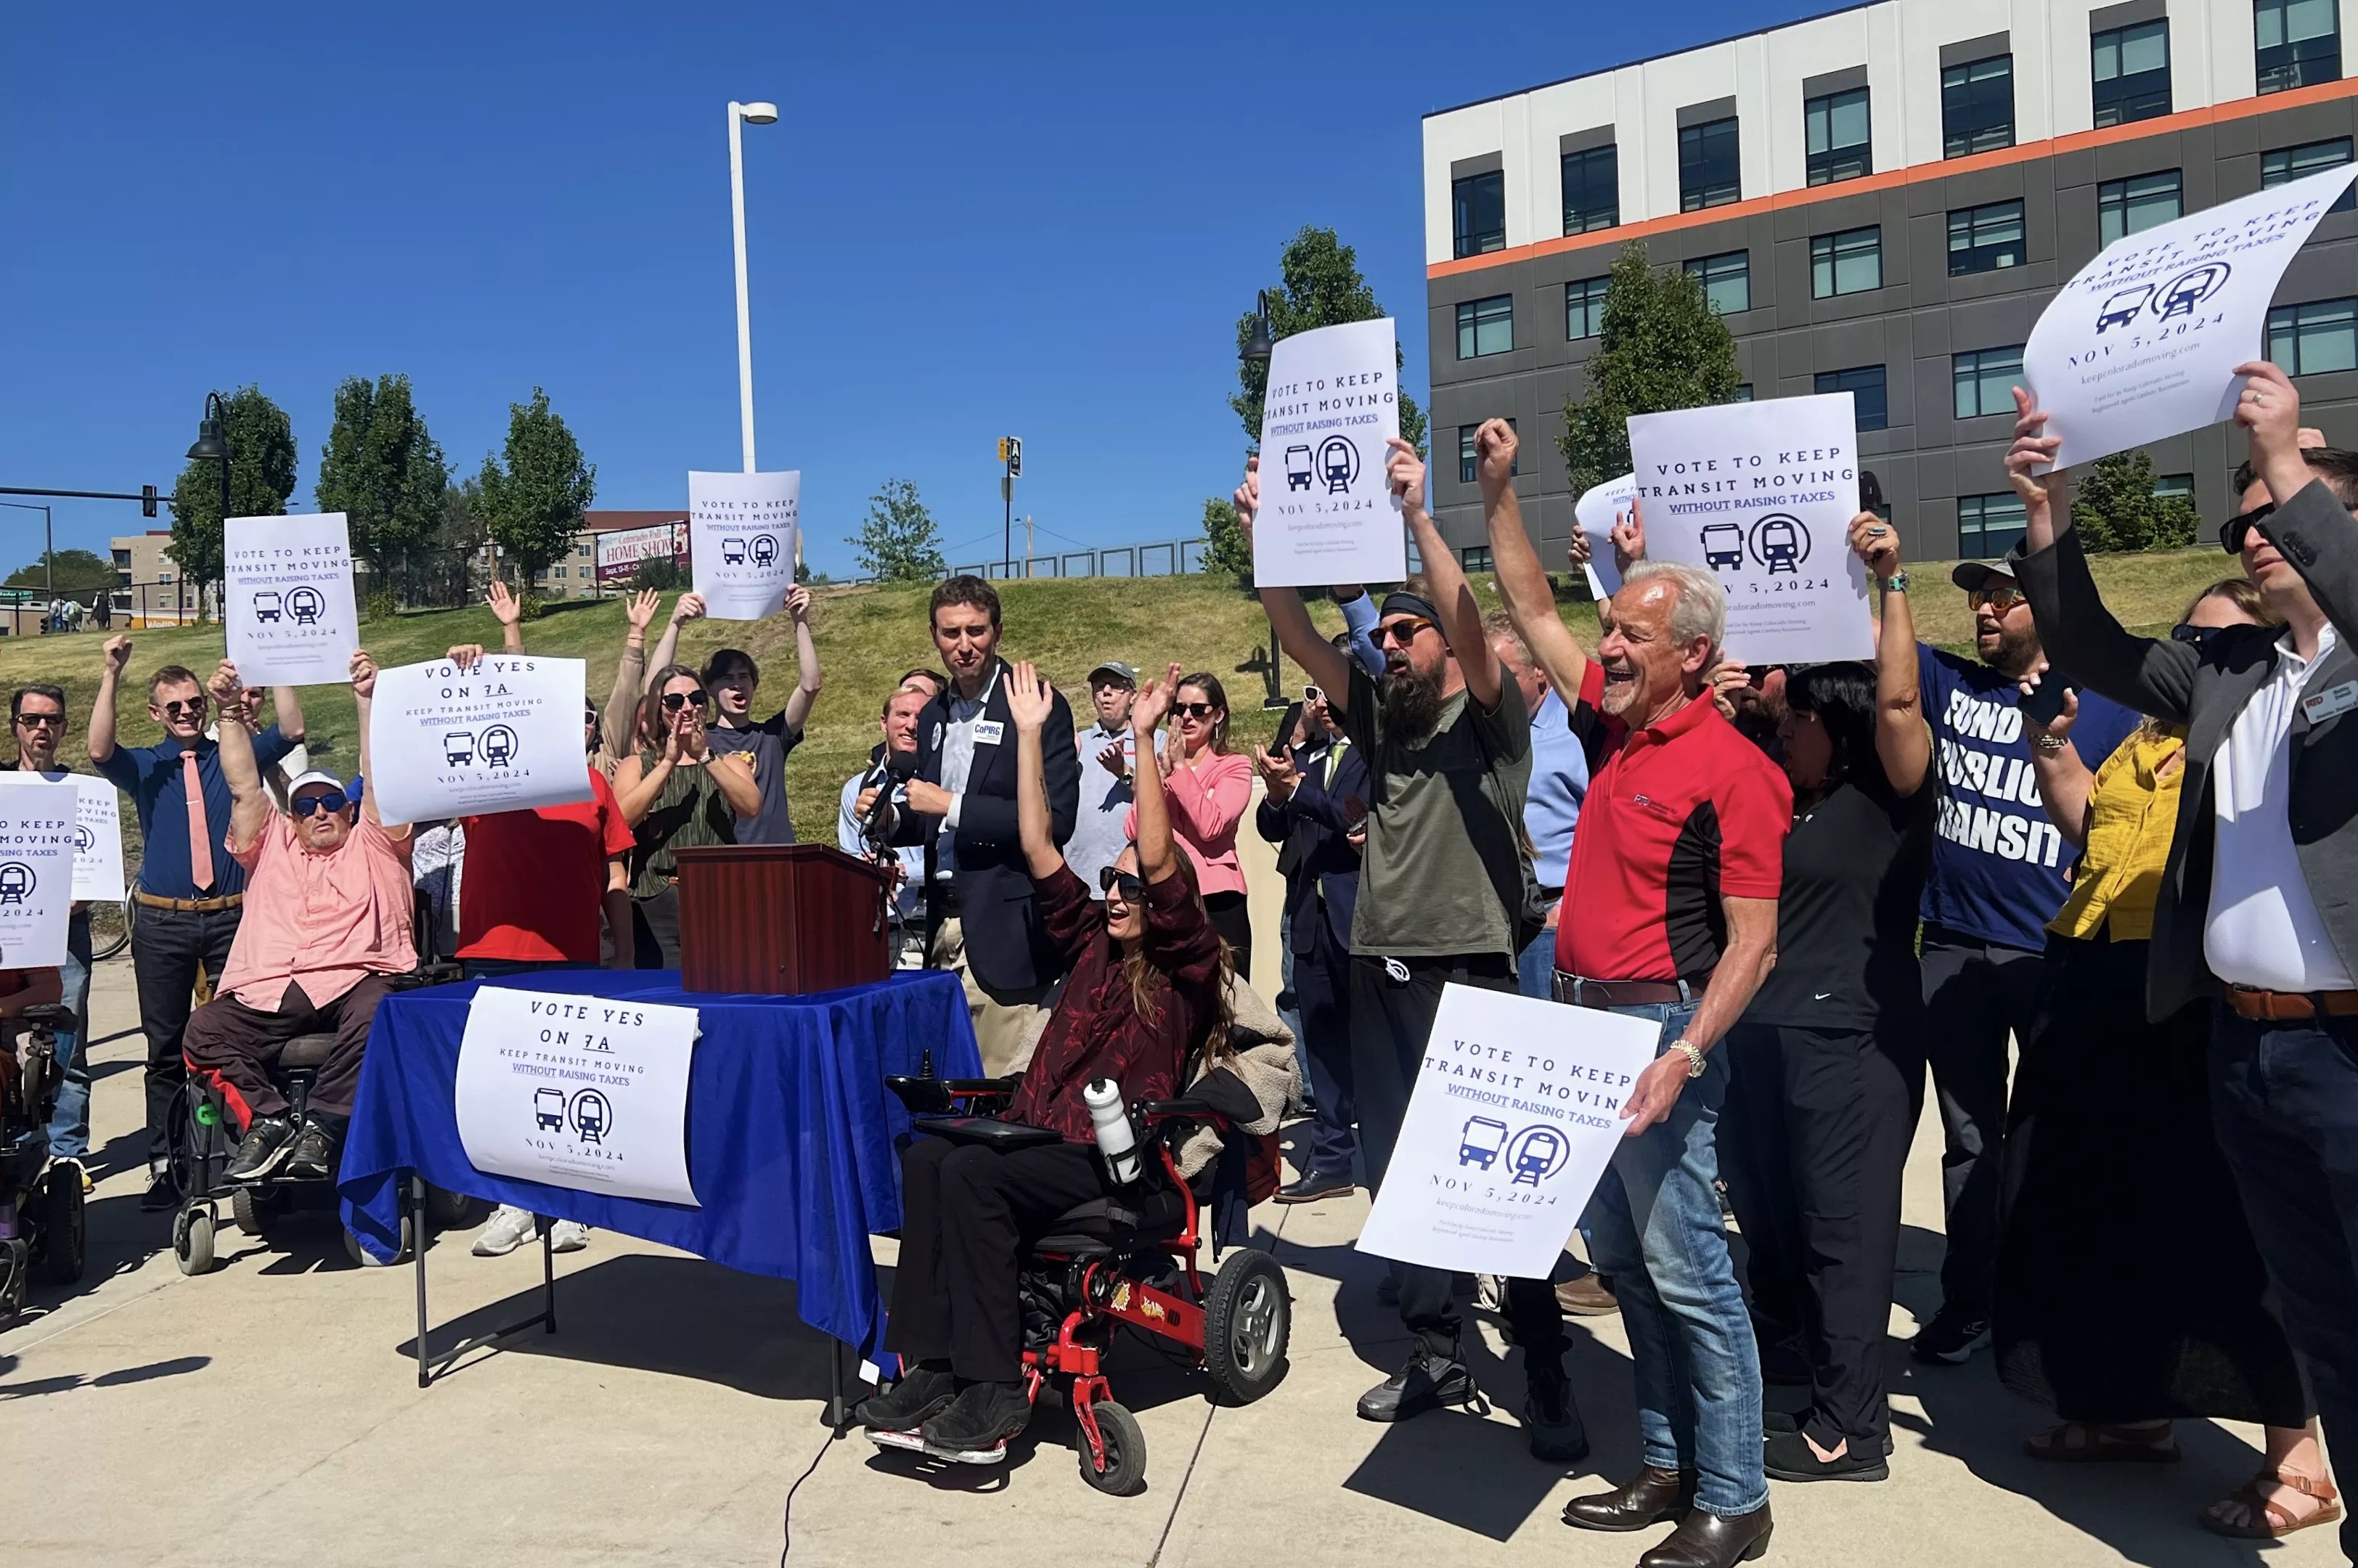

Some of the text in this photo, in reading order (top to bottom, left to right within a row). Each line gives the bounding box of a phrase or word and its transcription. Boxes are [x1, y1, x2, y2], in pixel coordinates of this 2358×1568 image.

[2105, 200, 2321, 266] VOTE TO KEEP
[2067, 212, 2323, 290] TRANSIT MOVING
[2090, 232, 2288, 292] WITHOUT RAISING TAXES
[2067, 312, 2224, 369] NOV 5,2024
[2081, 343, 2200, 385] keepcoloradomoving.com
[1272, 372, 1383, 399] VOTE TO KEEP
[1264, 392, 1393, 422] TRANSIT MOVING
[1270, 414, 1379, 437] WITHOUT RAISING TAXES
[1657, 447, 1840, 475] VOTE TO KEEP
[1639, 469, 1853, 498] TRANSIT MOVING
[766, 499, 794, 508] KEEP
[1278, 499, 1374, 516] NOV 5,2024
[1613, 494, 1635, 505] WITHO
[1670, 491, 1835, 515] WITHOUT RAISING TAXES
[691, 510, 797, 520] TRANSIT MOVING
[619, 534, 648, 544] Colorado
[650, 528, 661, 539] Fall
[234, 550, 265, 559] VOTE
[303, 546, 340, 556] KEEP
[607, 539, 674, 563] HOME SHOW
[226, 559, 349, 573] TRANSIT MOVING
[275, 574, 309, 584] RAISING
[1750, 579, 1829, 594] 5,2024
[285, 628, 337, 638] 5,2024
[425, 662, 535, 679] VOTE YES
[441, 684, 513, 699] ON 7A
[406, 698, 543, 716] KEEP TRANSIT MOVING
[420, 709, 531, 727] WITHOUT RAISING TAXES
[1943, 688, 2023, 744] FUND
[974, 724, 1000, 735] CoPIRG
[438, 769, 530, 784] NOV 5,2024
[1938, 738, 2043, 807] PUBLIC
[76, 807, 117, 817] OVING
[78, 798, 111, 807] KEEP
[0, 820, 65, 829] O KEEP
[531, 1001, 644, 1026] VOTE YES
[539, 1029, 615, 1053] ON 7A
[500, 1048, 645, 1074] KEEP TRANSIT MOVING
[1453, 1040, 1631, 1087] VOTE TO KEEP
[512, 1063, 630, 1087] WITHOUT RAISING TAXES
[1424, 1056, 1619, 1111] TRANSIT MOVIN
[1445, 1083, 1612, 1130] WITHOUT RAISING TAXES
[525, 1138, 624, 1161] NOV 5,2024
[1429, 1175, 1559, 1206] NOV 5,2024
[1436, 1198, 1534, 1221] keepcoloradomoving.com
